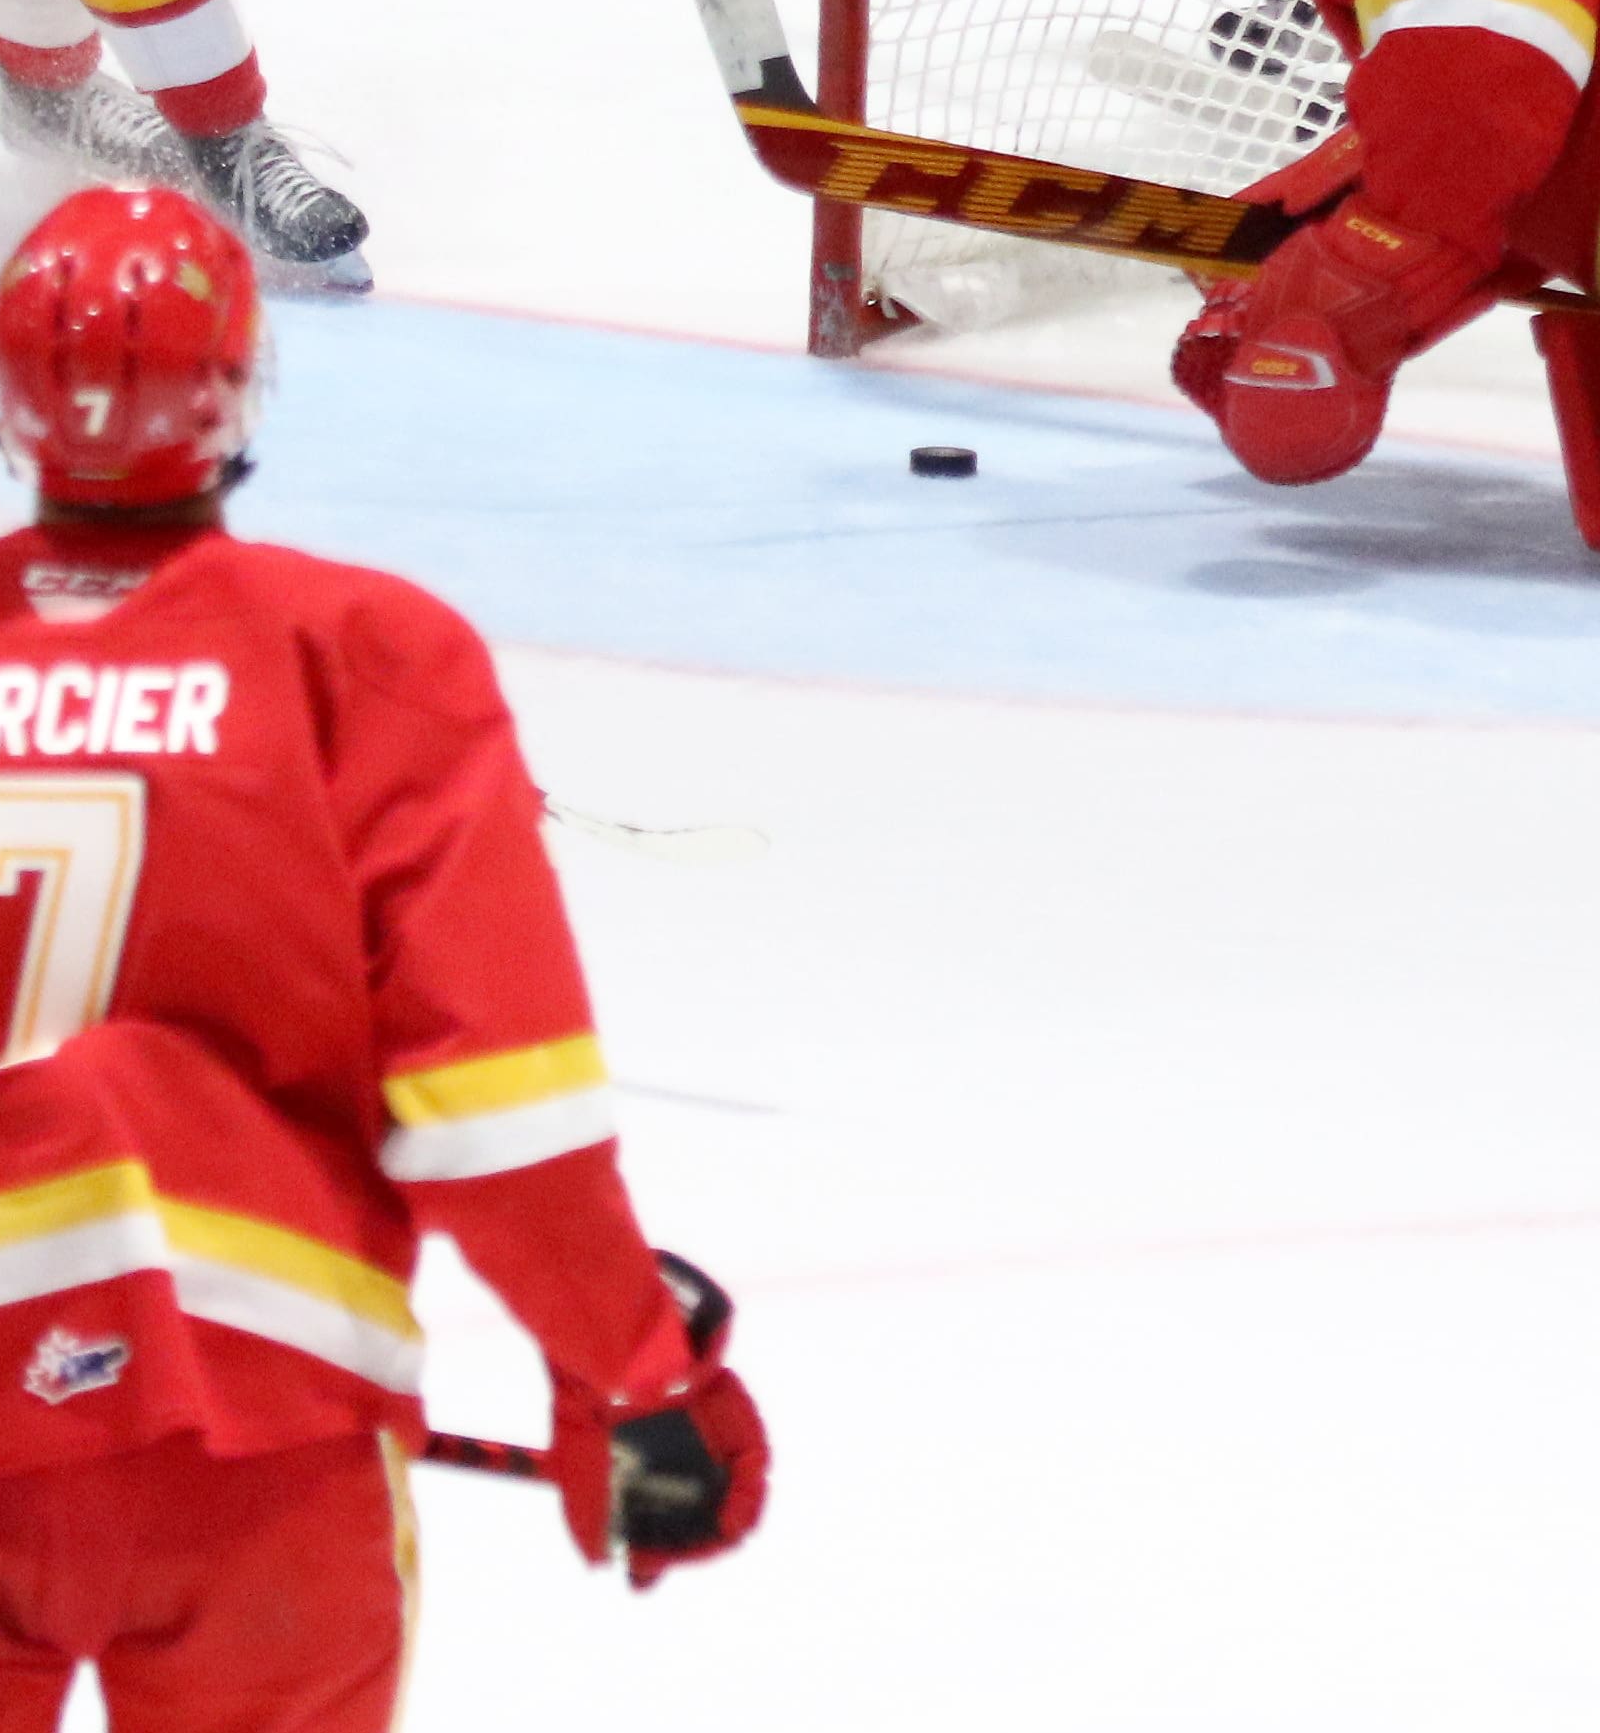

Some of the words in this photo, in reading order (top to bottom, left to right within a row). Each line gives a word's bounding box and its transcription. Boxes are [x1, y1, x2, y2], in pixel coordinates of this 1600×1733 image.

[812, 136, 1252, 252] CCM
[1344, 217, 1403, 251] CCM
[76, 390, 113, 438] 7
